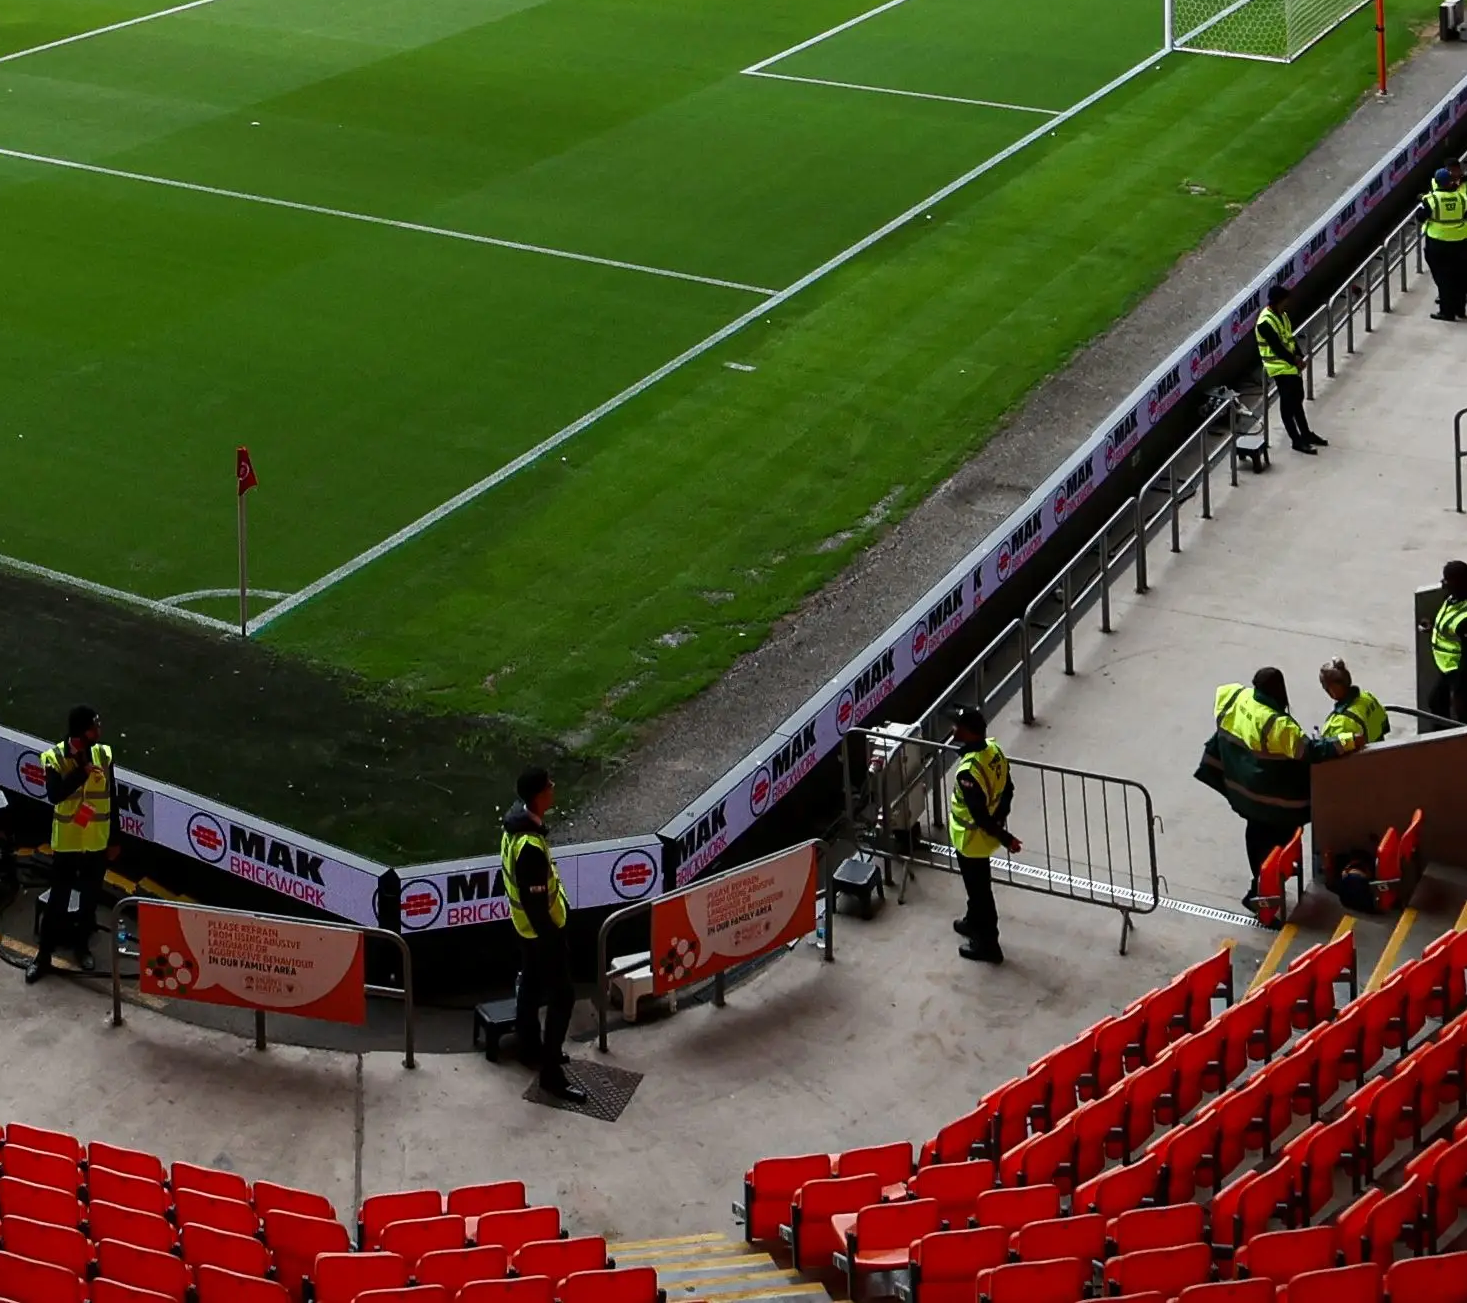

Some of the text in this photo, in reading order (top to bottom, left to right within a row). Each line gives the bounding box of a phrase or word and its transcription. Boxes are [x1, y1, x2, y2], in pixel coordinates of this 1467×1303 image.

[1114, 409, 1138, 447] MAK
[1067, 457, 1093, 497] MAK
[1012, 510, 1042, 555] MAK
[928, 584, 963, 633] MAK
[854, 648, 896, 704] MAK
[772, 721, 816, 781] MAK
[676, 799, 728, 860] MAK
[229, 824, 325, 887] MAK
[230, 855, 326, 907] BRICKWORK
[208, 921, 278, 938] PLEASE REFRAIN
[208, 929, 301, 949] FROM USING ABUSIVE
[208, 955, 297, 976] IN OUR FAMILY AREA
[263, 954, 314, 968] BEHAVIOUR
